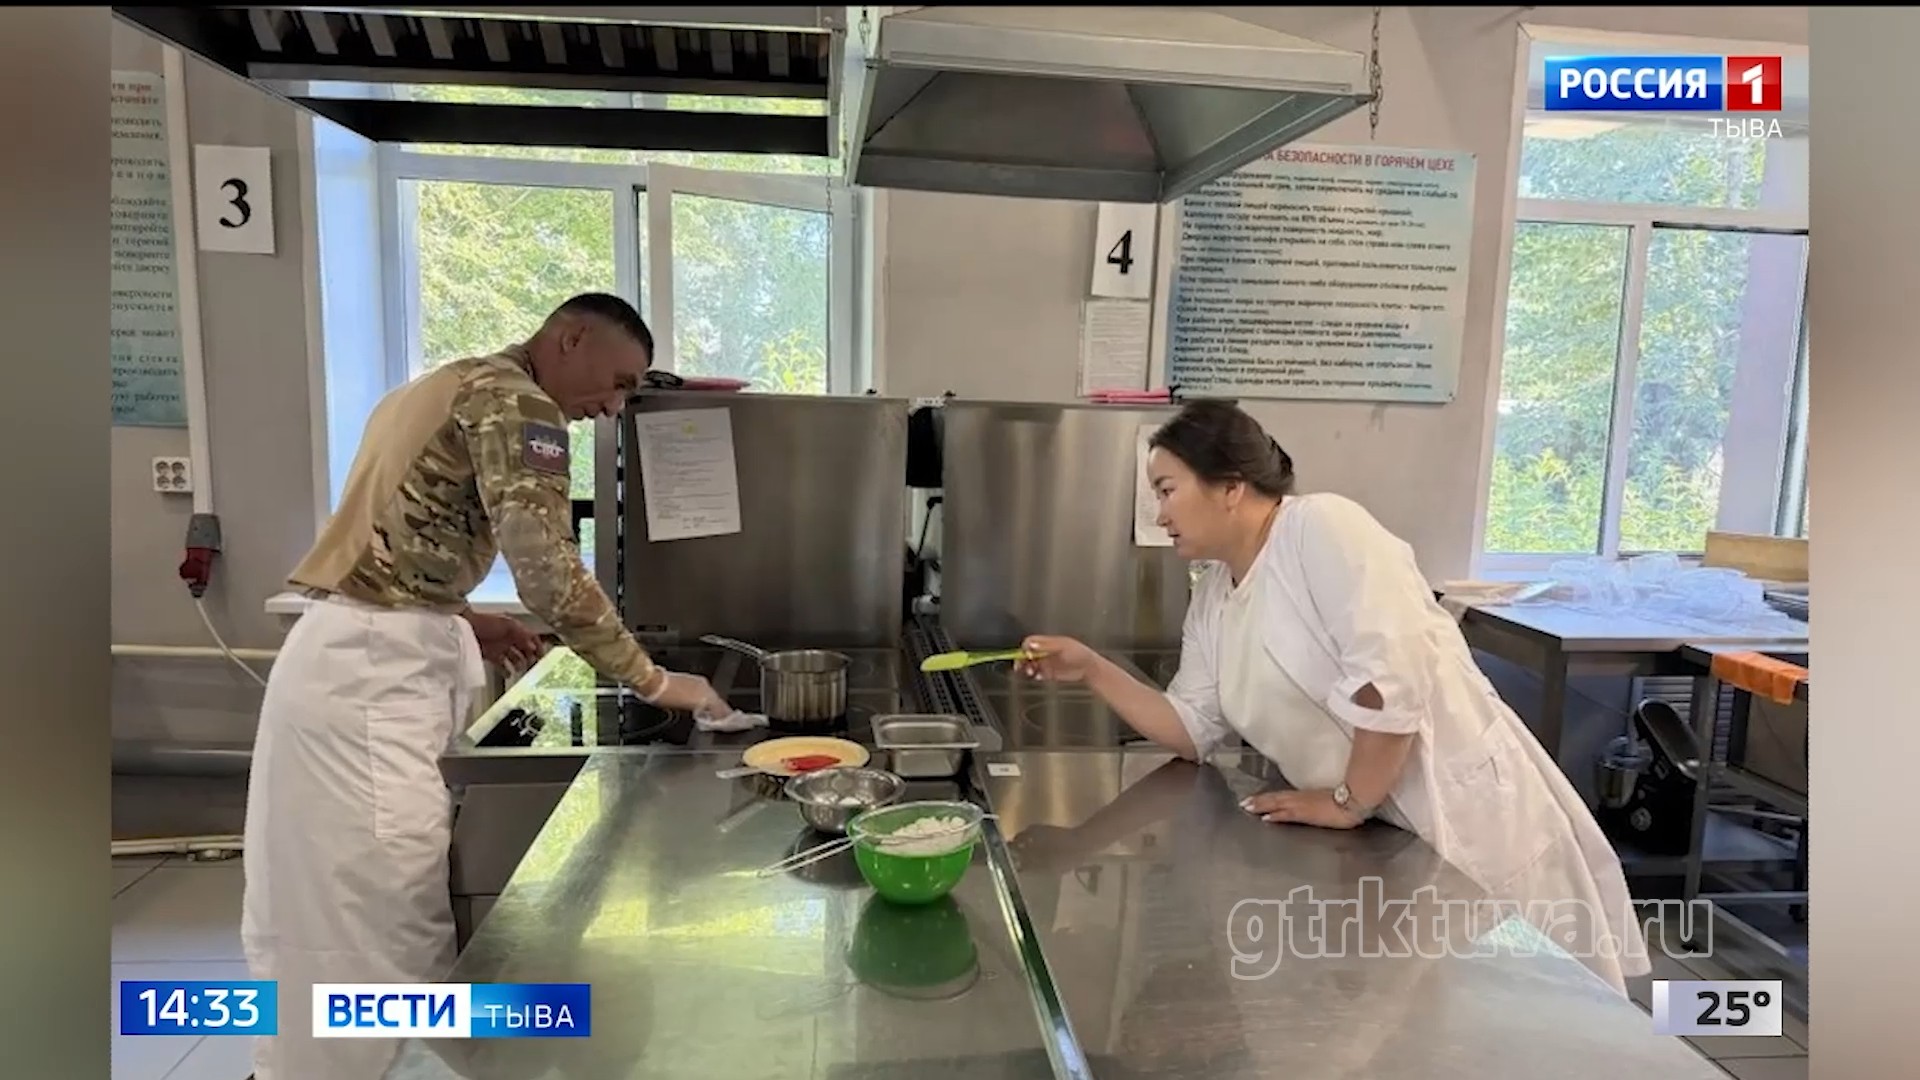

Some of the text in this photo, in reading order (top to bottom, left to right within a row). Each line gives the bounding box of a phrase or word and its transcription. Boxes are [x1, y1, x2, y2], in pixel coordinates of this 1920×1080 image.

[1277, 150, 1455, 172] БЕЗОПАСНОСТИ В ГОРЯЧЕМ ЦЕХЕ
[219, 178, 251, 228] 3
[1107, 230, 1134, 275] 4
